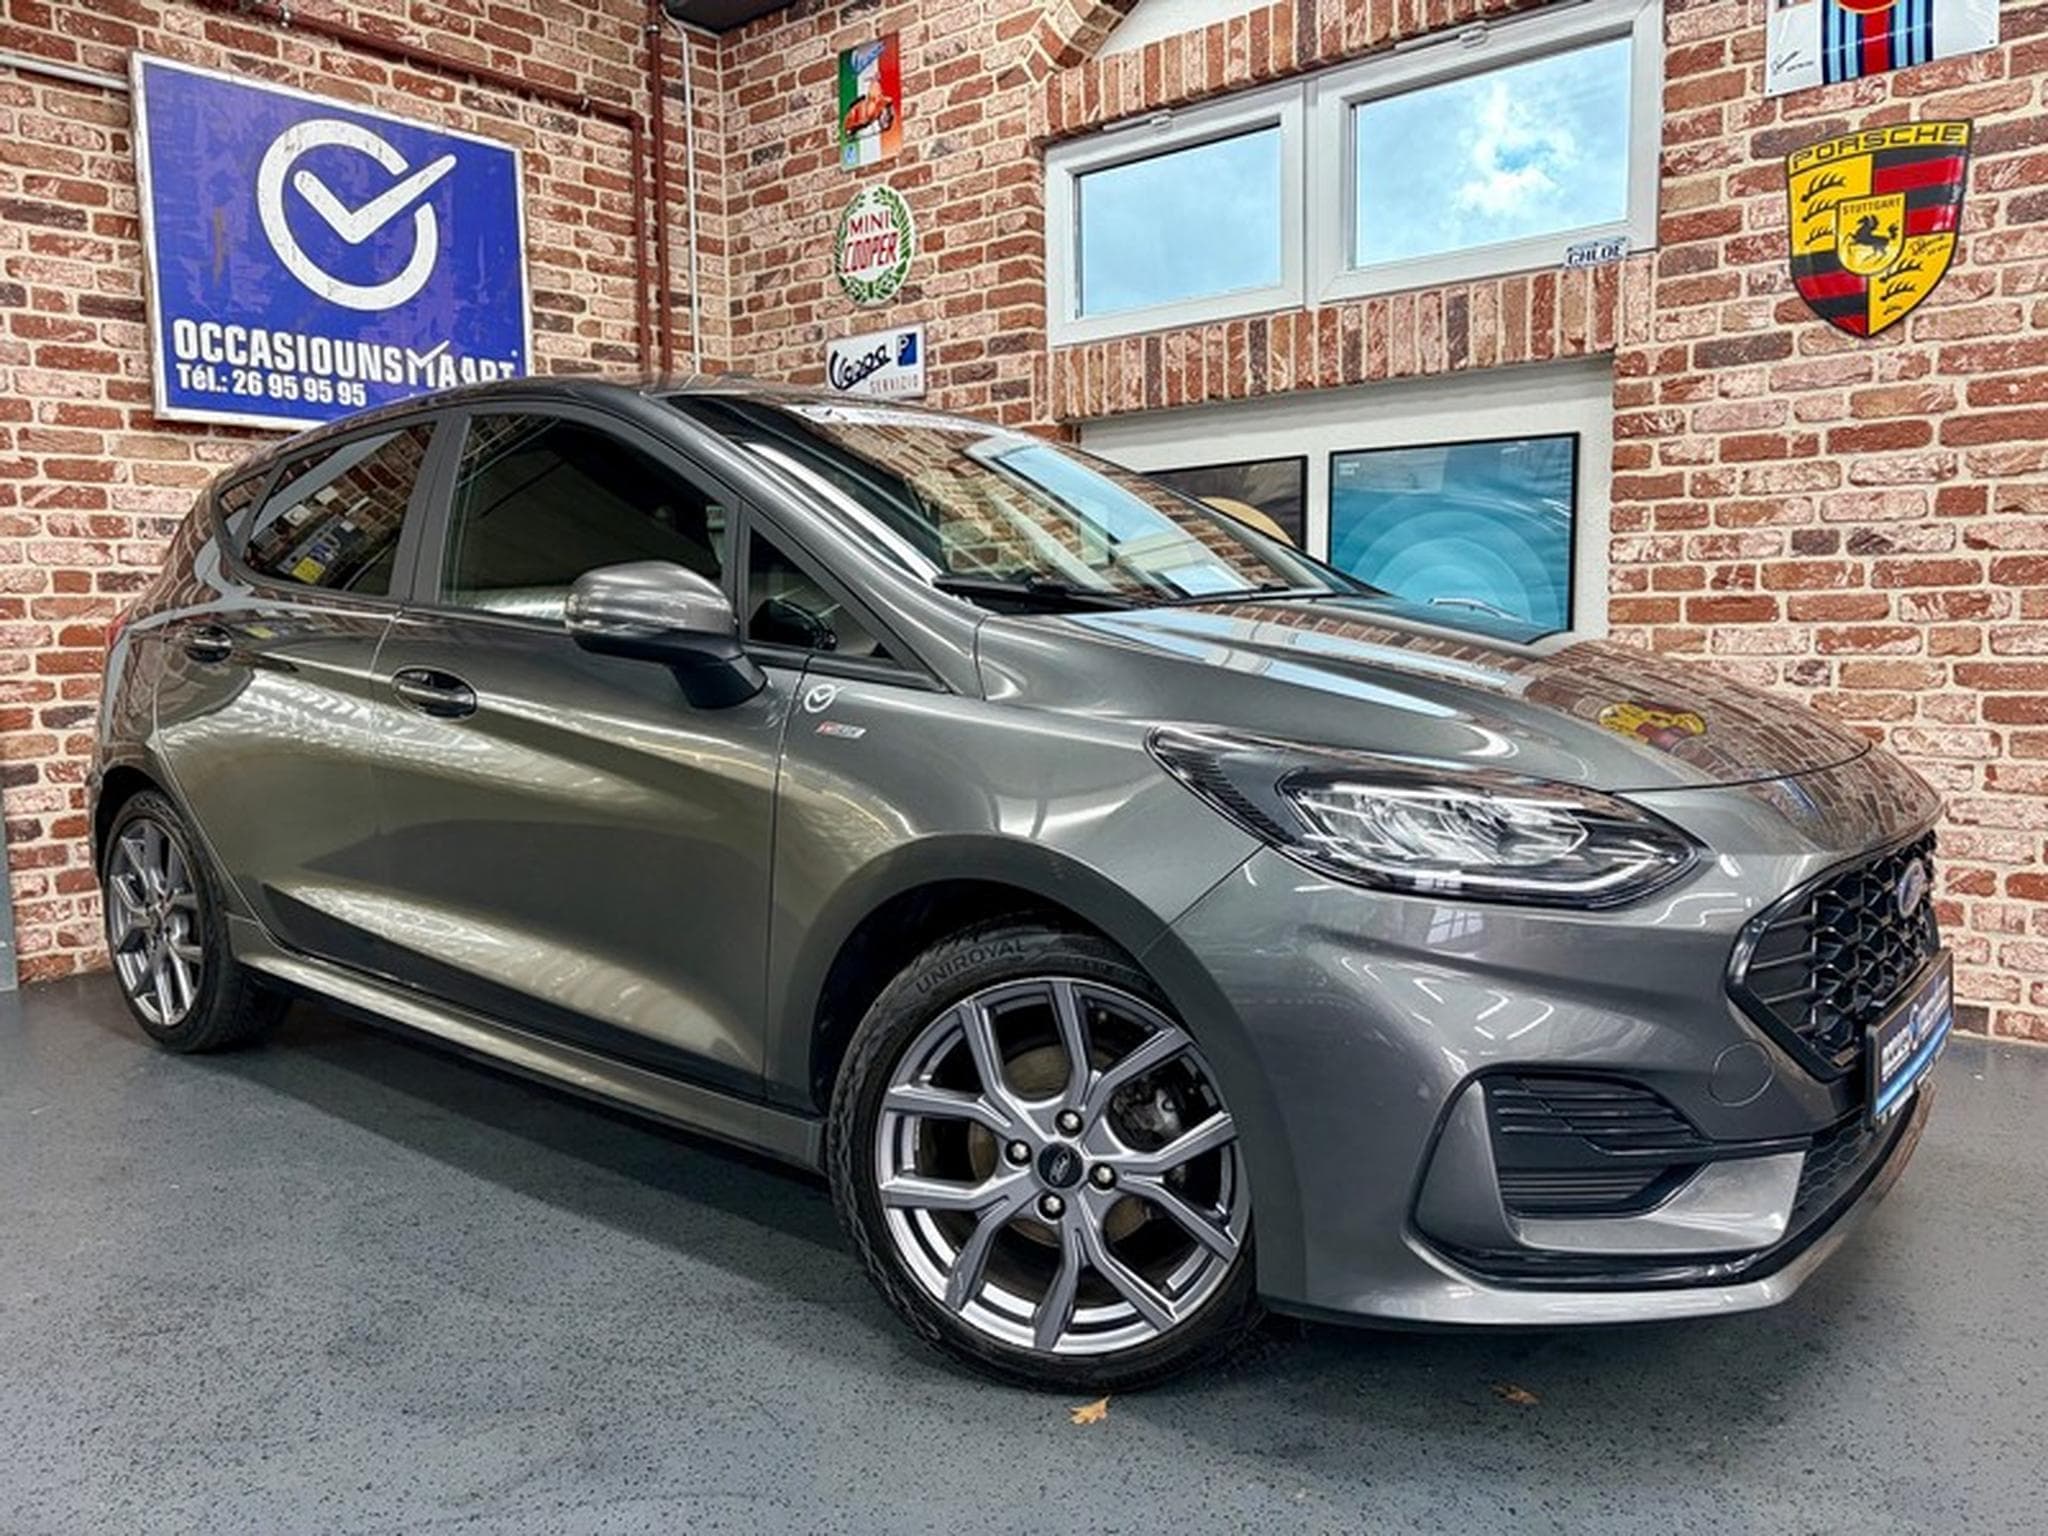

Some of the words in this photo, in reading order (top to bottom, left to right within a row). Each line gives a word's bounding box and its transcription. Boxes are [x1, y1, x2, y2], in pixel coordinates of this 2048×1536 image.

[1792, 124, 1965, 170] PORSCHE
[850, 208, 890, 237] MINI
[1842, 198, 1902, 216] STUTTGART
[843, 231, 898, 274] COOPER
[176, 362, 229, 393] Tél.:
[232, 372, 263, 395] 26
[268, 375, 299, 400] 95
[303, 379, 333, 403] 95
[337, 381, 367, 408] 95
[829, 342, 892, 391] Vespa
[915, 938, 1026, 995] UNIROYAL
